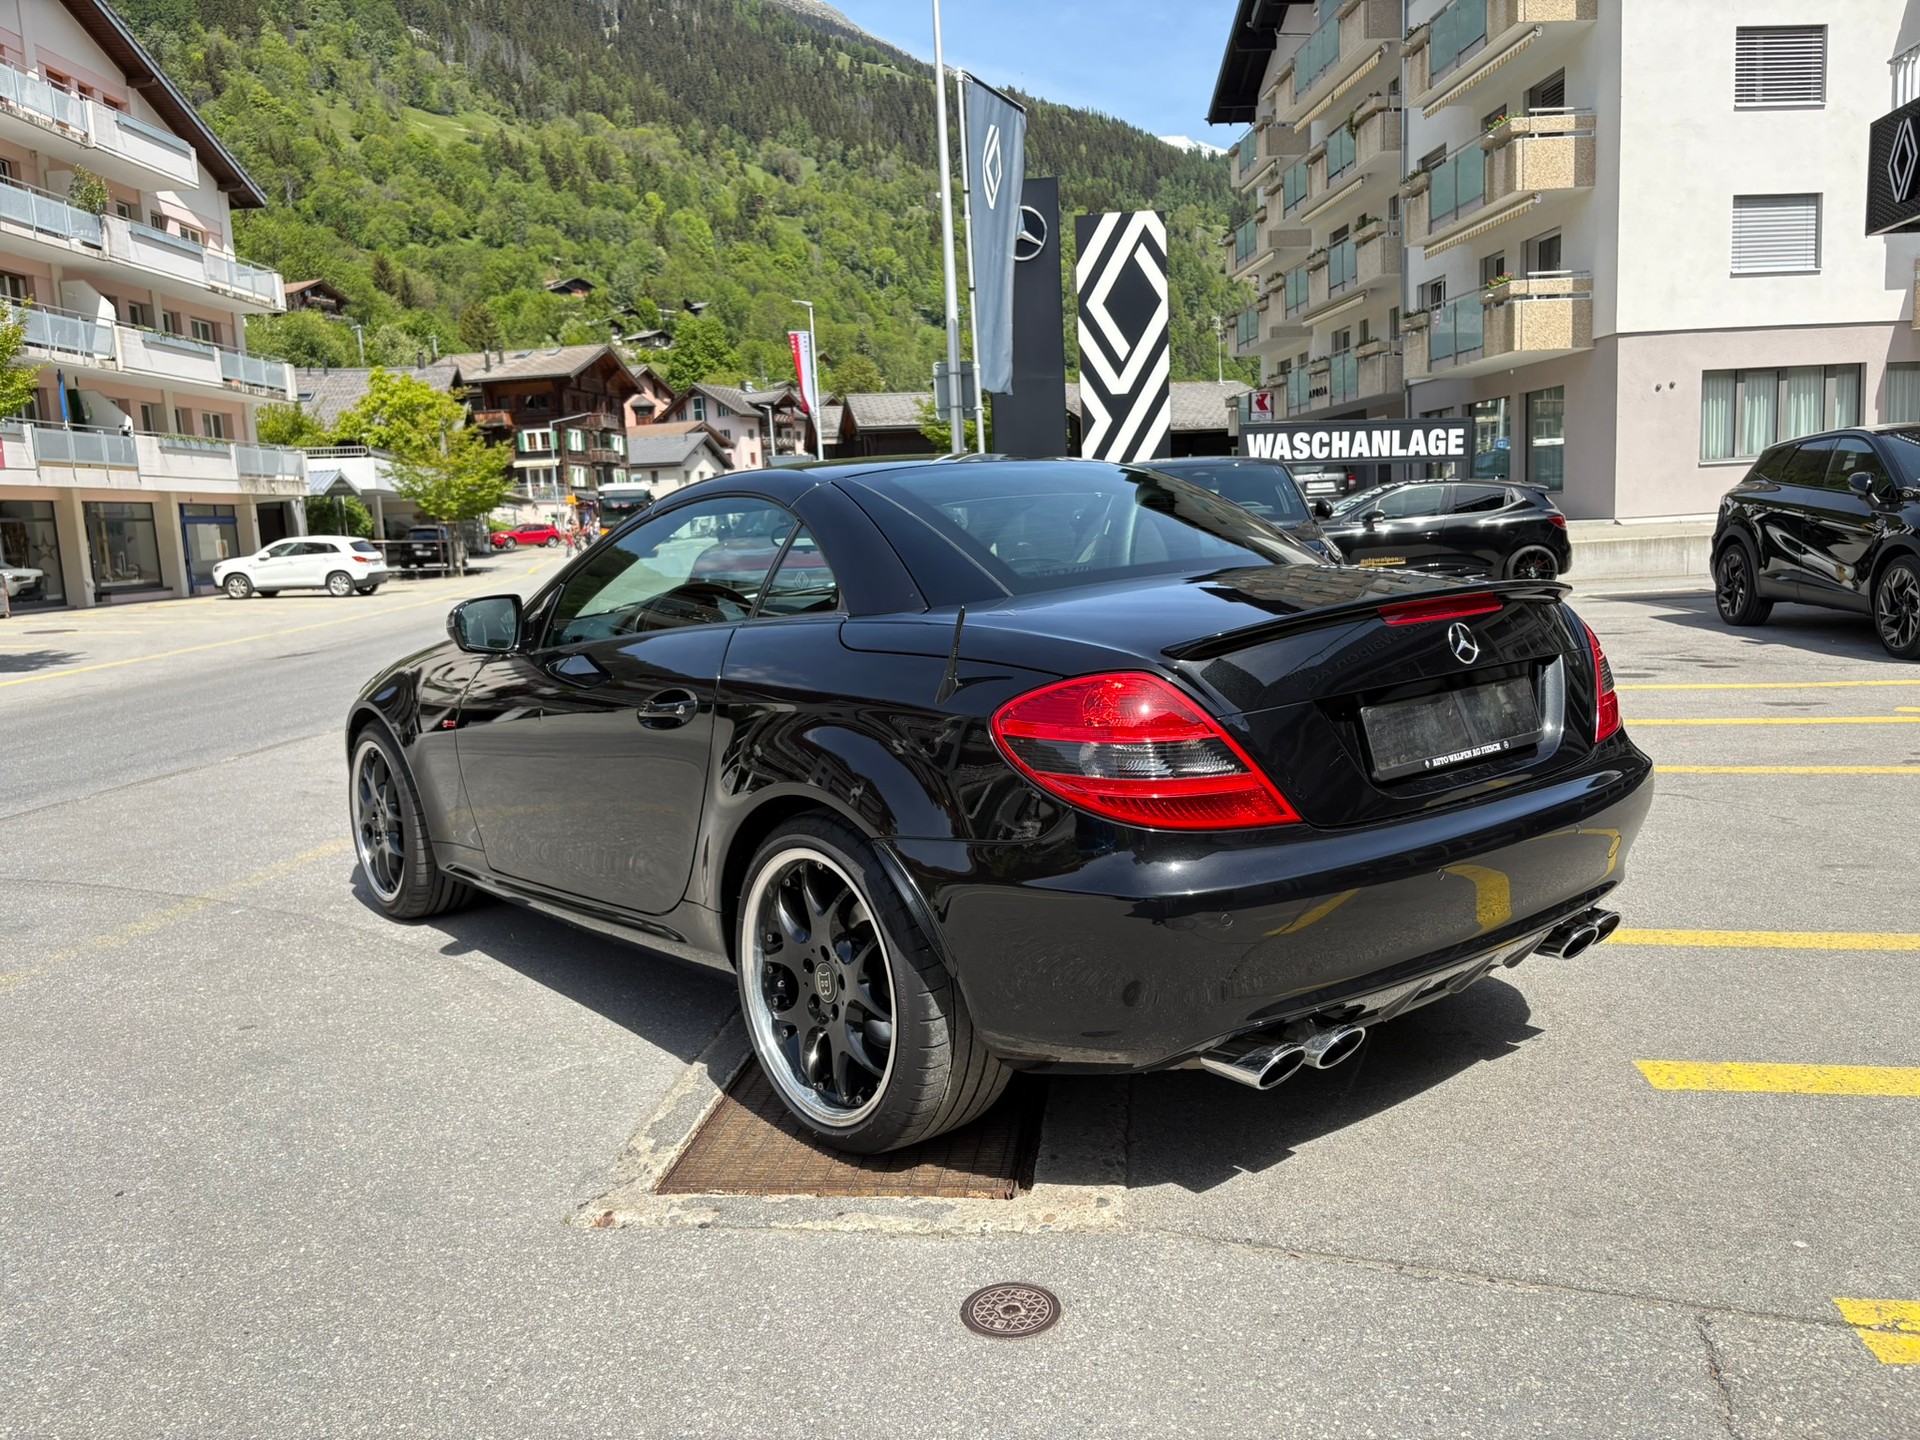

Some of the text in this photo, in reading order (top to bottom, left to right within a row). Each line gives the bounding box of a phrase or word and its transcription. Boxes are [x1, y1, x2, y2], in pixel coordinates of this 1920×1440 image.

[1246, 428, 1465, 461] WASCHANLAGE
[1432, 755, 1449, 767] AUTO
[1448, 749, 1472, 763] WALPEN
